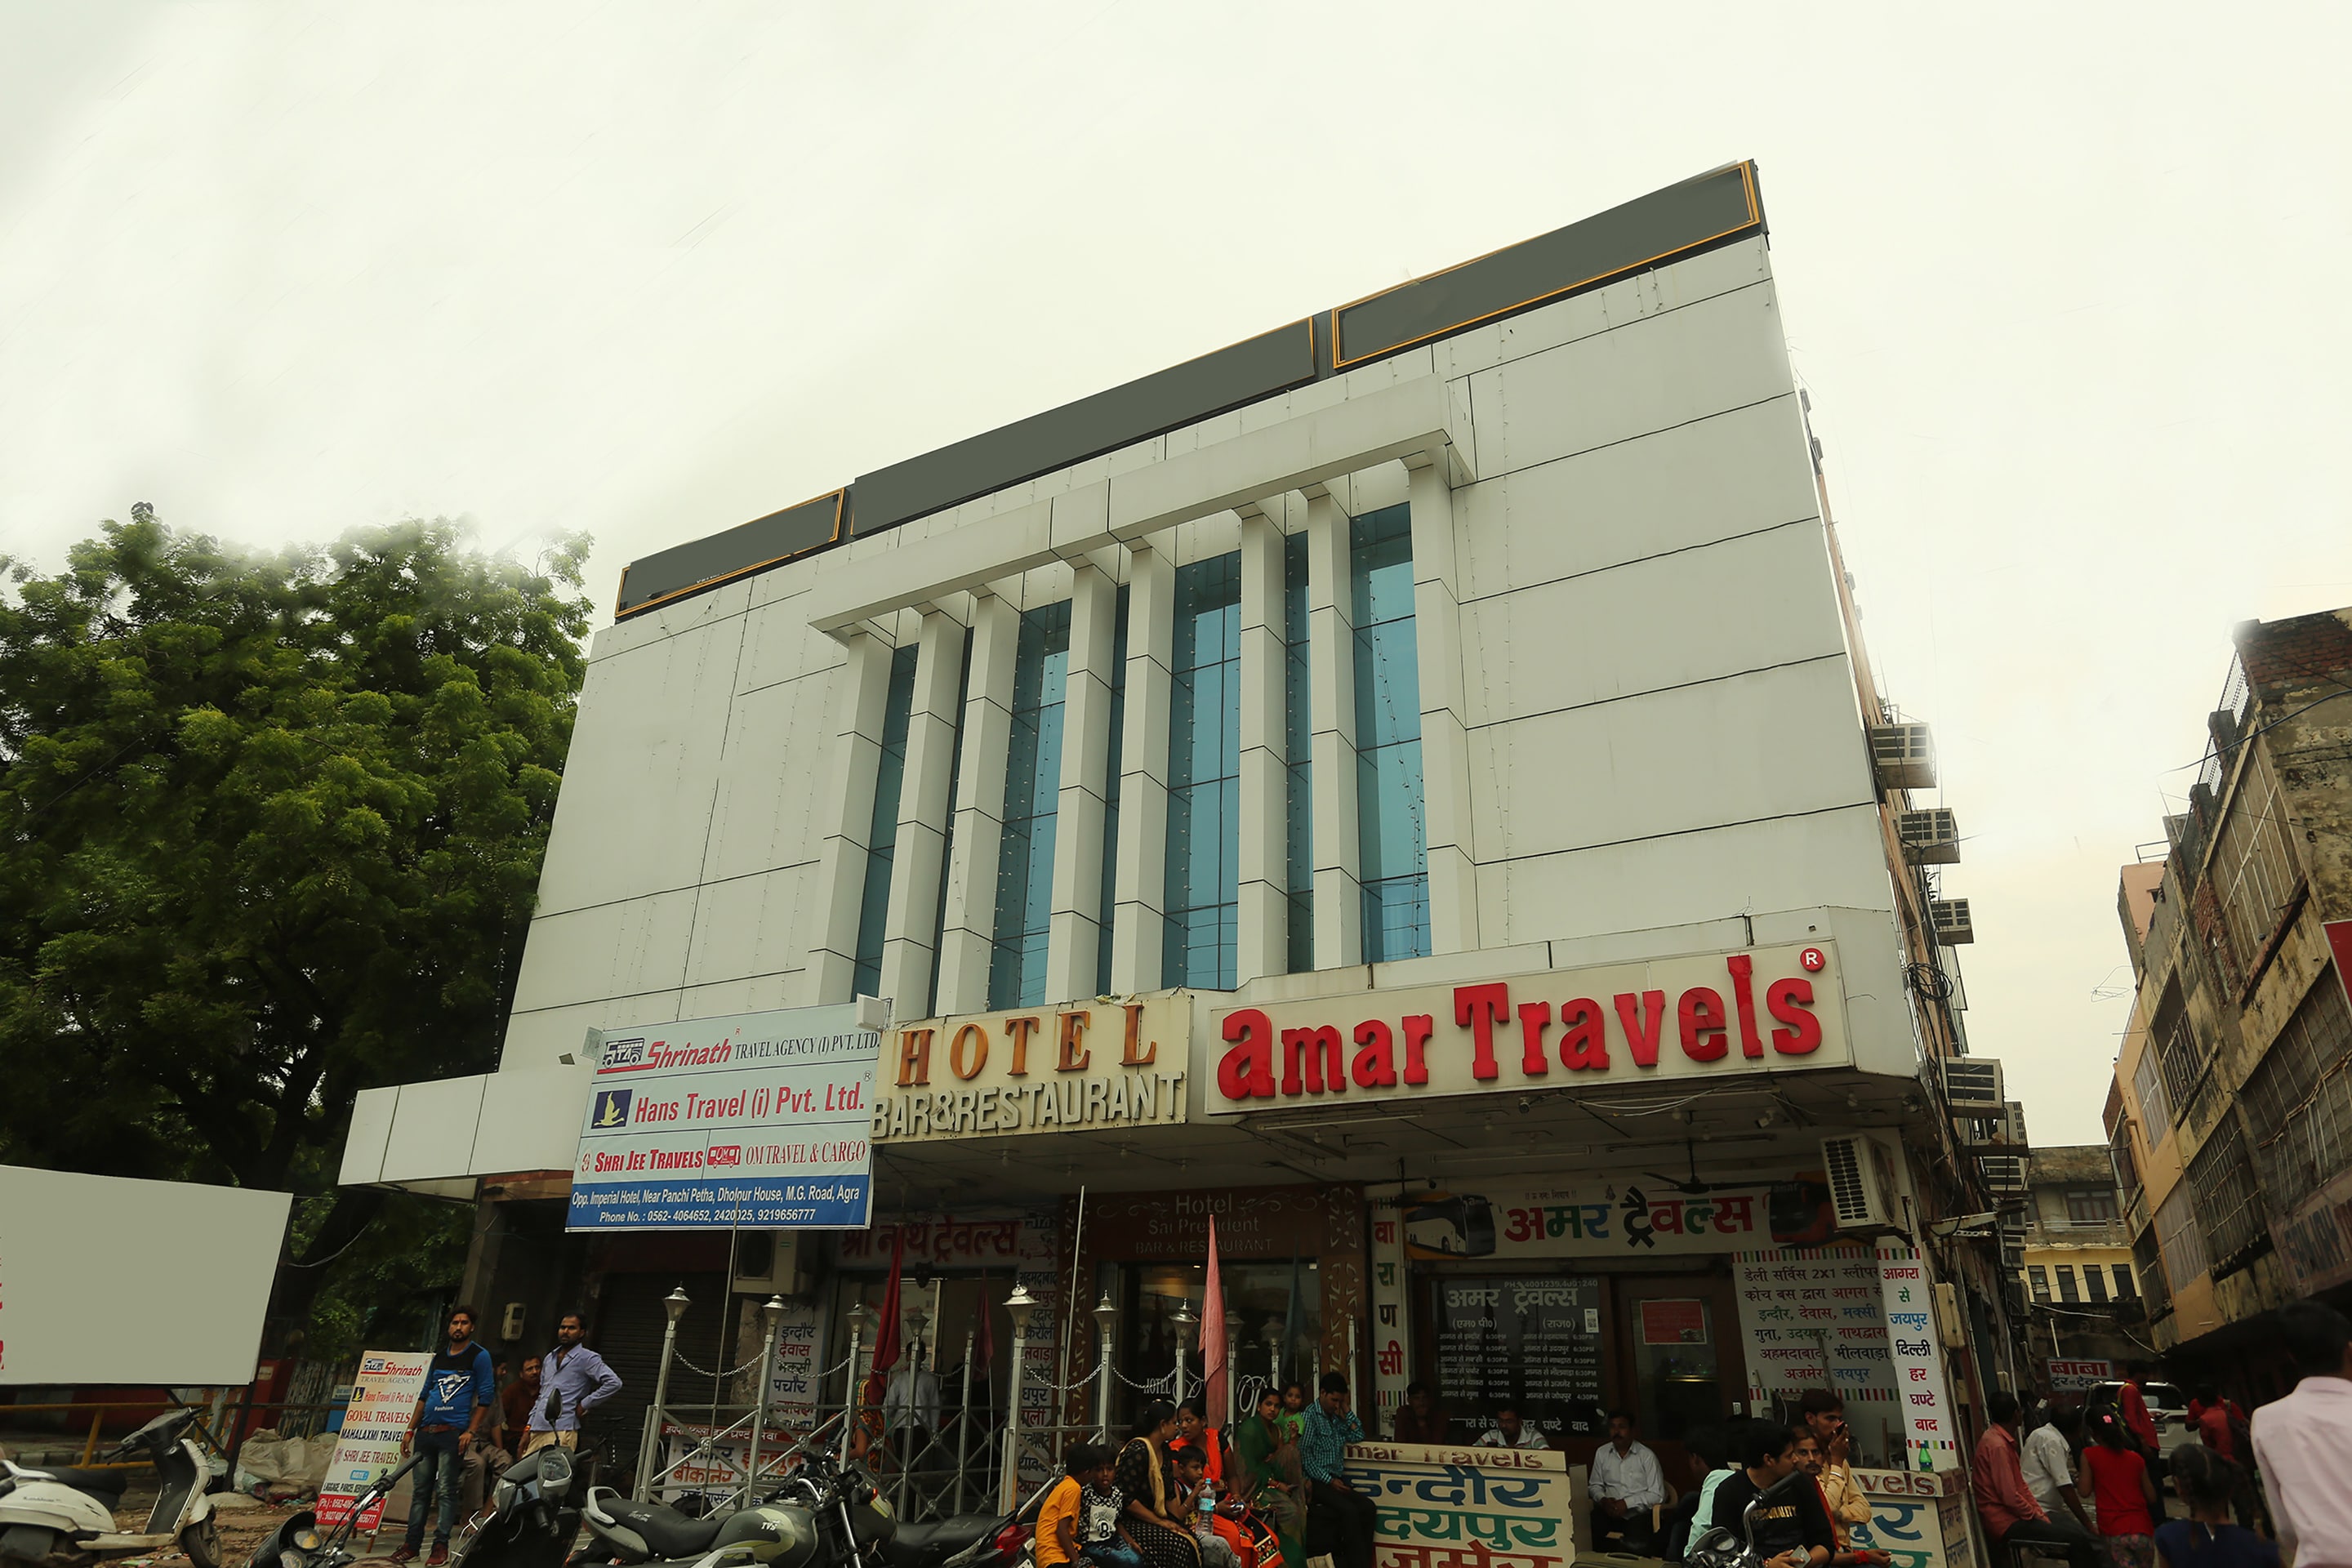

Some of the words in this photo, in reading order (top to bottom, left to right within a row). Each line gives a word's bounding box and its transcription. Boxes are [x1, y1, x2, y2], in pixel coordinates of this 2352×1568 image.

[1218, 1009, 1432, 1100] amar
[1453, 954, 1822, 1080] Travels
[648, 1038, 732, 1069] Shrinath
[735, 1041, 771, 1060] TRAVEL
[772, 1037, 817, 1056] AGENCY
[831, 1034, 853, 1052] PVT.
[858, 1032, 880, 1049] LTD.
[895, 1004, 1157, 1087] HOTEL
[635, 1097, 679, 1123] Hans
[687, 1089, 746, 1120] Travel
[751, 1088, 770, 1119] (i)
[775, 1086, 817, 1114] Pvt.
[825, 1081, 865, 1111] Ltd.
[595, 1152, 625, 1173] SHRI
[626, 1151, 646, 1171] JEE
[649, 1149, 704, 1170] TRAVELS
[746, 1146, 764, 1165] OM
[766, 1144, 807, 1165] TRAVEL
[809, 1143, 818, 1163] &
[822, 1140, 866, 1163] CARGO
[572, 1192, 589, 1208] Opp.
[590, 1191, 619, 1208] Imperial
[620, 1189, 641, 1206] Hotel,
[642, 1189, 661, 1203] Near
[662, 1188, 690, 1203] Panchi
[690, 1188, 715, 1205] Petha,
[754, 1186, 783, 1204] House,
[786, 1186, 805, 1201] M.G.
[808, 1185, 835, 1202] Road,
[836, 1184, 859, 1204] Agra
[1176, 1192, 1232, 1215] Hotel
[599, 1211, 625, 1223] Phone
[758, 1209, 816, 1221] 9219656777
[1504, 1204, 1612, 1242] अमर
[1178, 1216, 1259, 1234] Preident
[1136, 1241, 1162, 1254] BAR
[1166, 1241, 1174, 1253] &
[1179, 1238, 1273, 1254] RESAURANT
[1744, 1267, 1767, 1282] डेली
[1773, 1266, 1806, 1282] सर्विस
[1883, 1267, 1919, 1280] आगरा
[1447, 1289, 1501, 1307] अमर
[1744, 1287, 1771, 1302] कोच
[1776, 1289, 1796, 1301] बस
[1801, 1288, 1826, 1302] द्वारा
[1832, 1287, 1869, 1300] आगरा
[1898, 1286, 1910, 1303] से
[1798, 1305, 1838, 1321] देवास,
[1842, 1303, 1878, 1320] मक्सी
[1889, 1313, 1927, 1331] जयपुर
[782, 1322, 816, 1340] इन्दौर
[1755, 1329, 1781, 1343] गुना,
[1837, 1327, 1888, 1340] नाथद्वारा
[779, 1340, 811, 1357] देवास
[1896, 1339, 1931, 1356] दिल्ली
[385, 1361, 422, 1376] Shrinath
[1833, 1368, 1870, 1383] जयपुर
[1909, 1368, 1927, 1381] हर
[376, 1391, 390, 1402] Travel
[1909, 1390, 1936, 1406] घण्टे
[346, 1410, 372, 1422] GOYAL
[375, 1411, 412, 1423] TRAVELS
[1915, 1419, 1938, 1432] बाद
[341, 1428, 379, 1441] MAHALAXMI
[380, 1430, 404, 1442] TRAVEL
[343, 1450, 358, 1463] SHRI
[359, 1450, 372, 1463] JEE
[372, 1451, 399, 1464] TRAVELS
[1346, 1444, 1403, 1460] mar
[1424, 1449, 1543, 1468] Travels
[1859, 1472, 1935, 1495] vels
[761, 1521, 777, 1531] TVS
[1374, 1506, 1561, 1551] दयपुर
